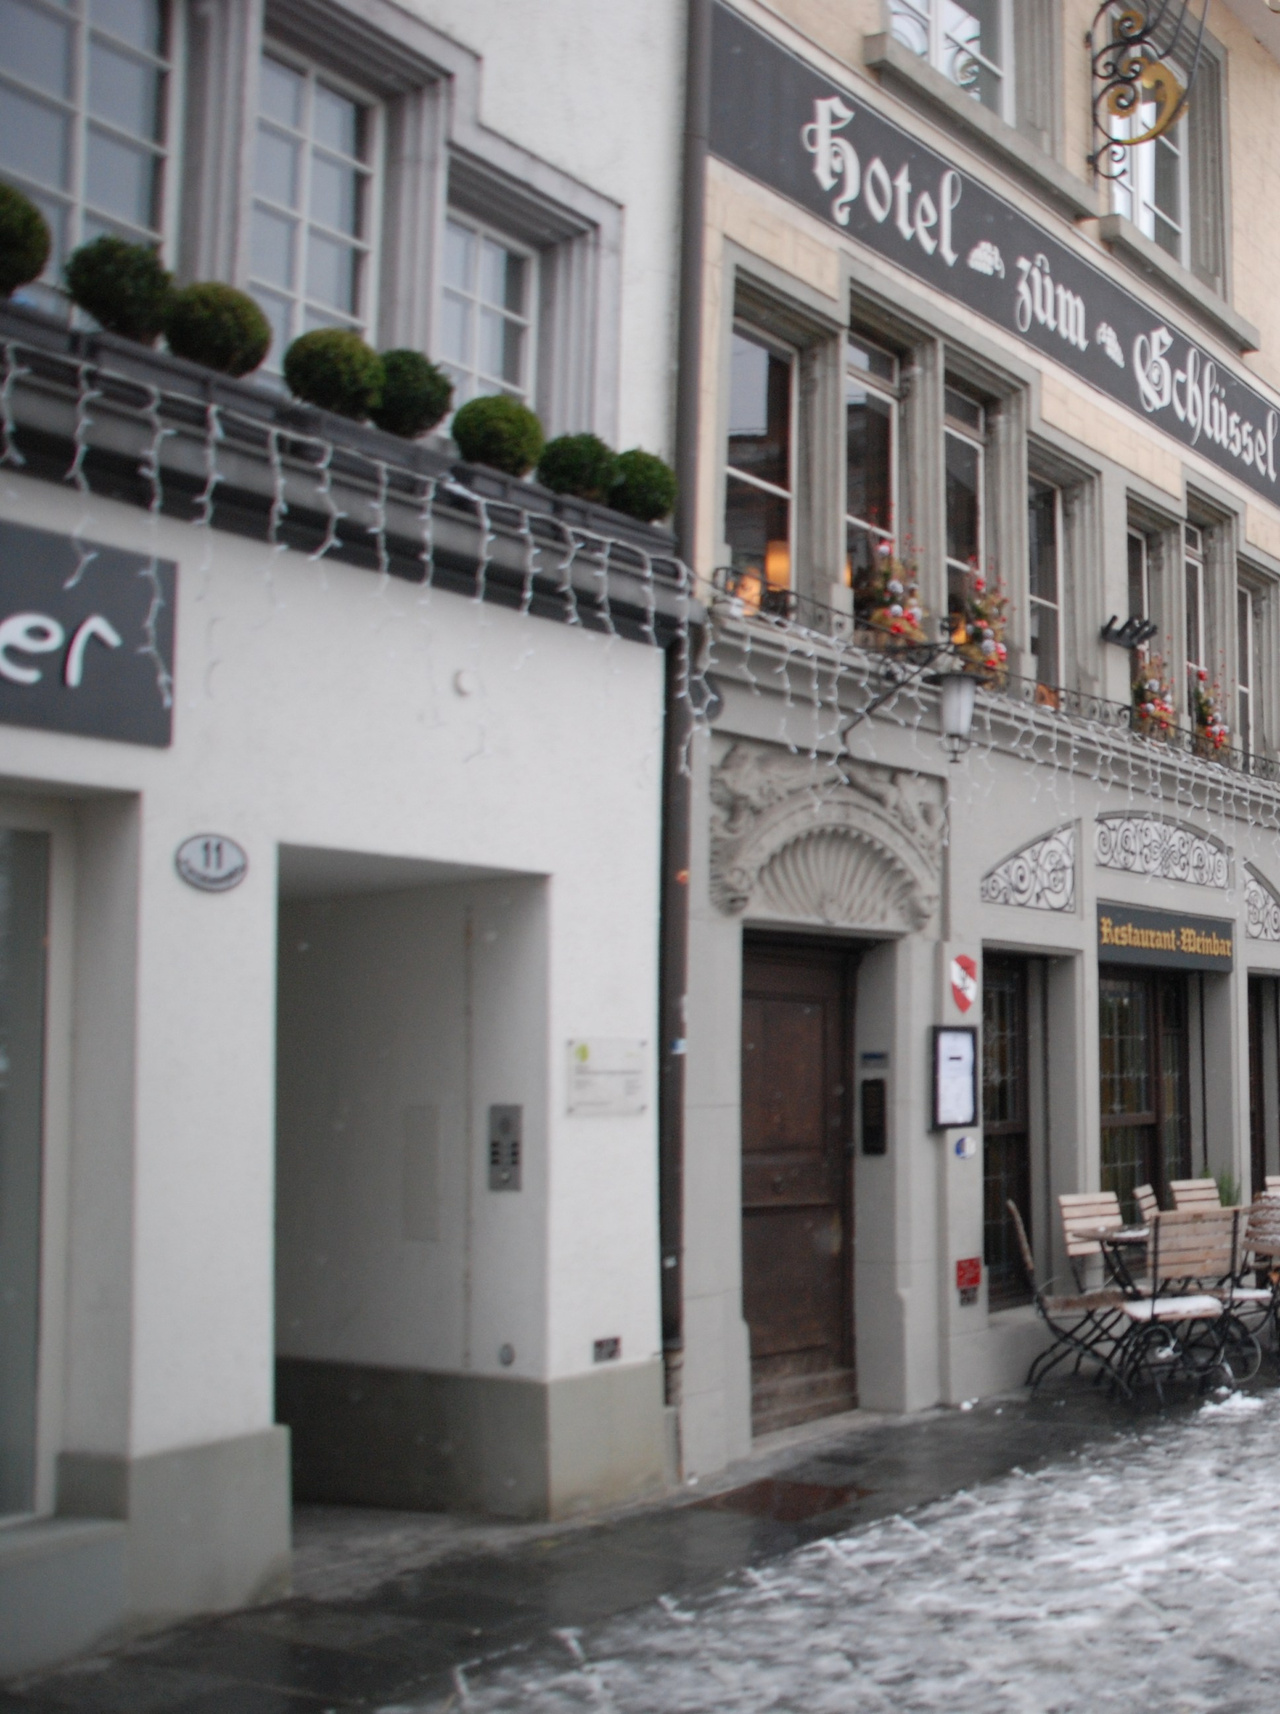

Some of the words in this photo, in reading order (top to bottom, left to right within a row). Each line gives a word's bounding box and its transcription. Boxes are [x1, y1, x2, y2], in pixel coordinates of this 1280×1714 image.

[802, 96, 962, 268] Hotel
[1133, 326, 1278, 483] Schlüssel
[202, 840, 223, 870] 11
